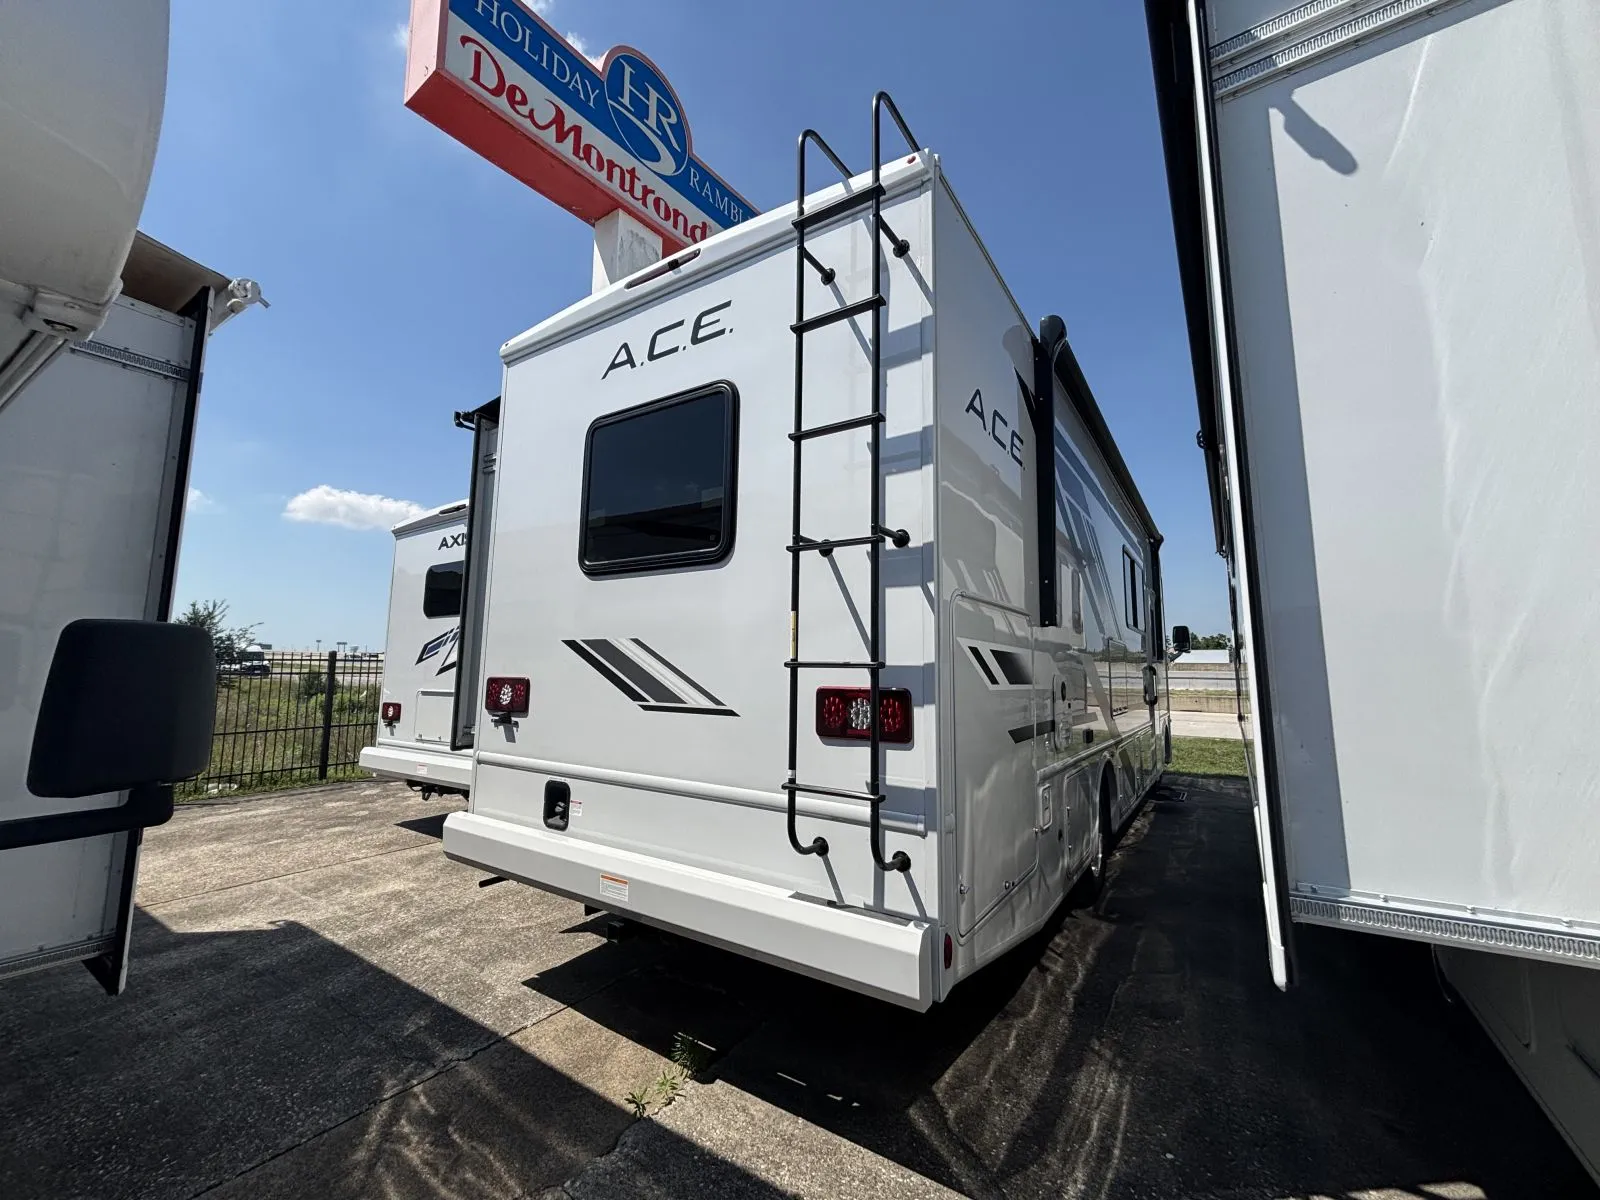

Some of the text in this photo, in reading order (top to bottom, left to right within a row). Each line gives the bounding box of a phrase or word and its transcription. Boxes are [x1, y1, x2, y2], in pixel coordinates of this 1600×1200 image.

[475, 0, 599, 109] HOLIDAY
[460, 35, 708, 244] DeMontrond
[618, 58, 681, 153] HR
[689, 166, 751, 223] RAMBL
[601, 300, 734, 380] A.C.E.
